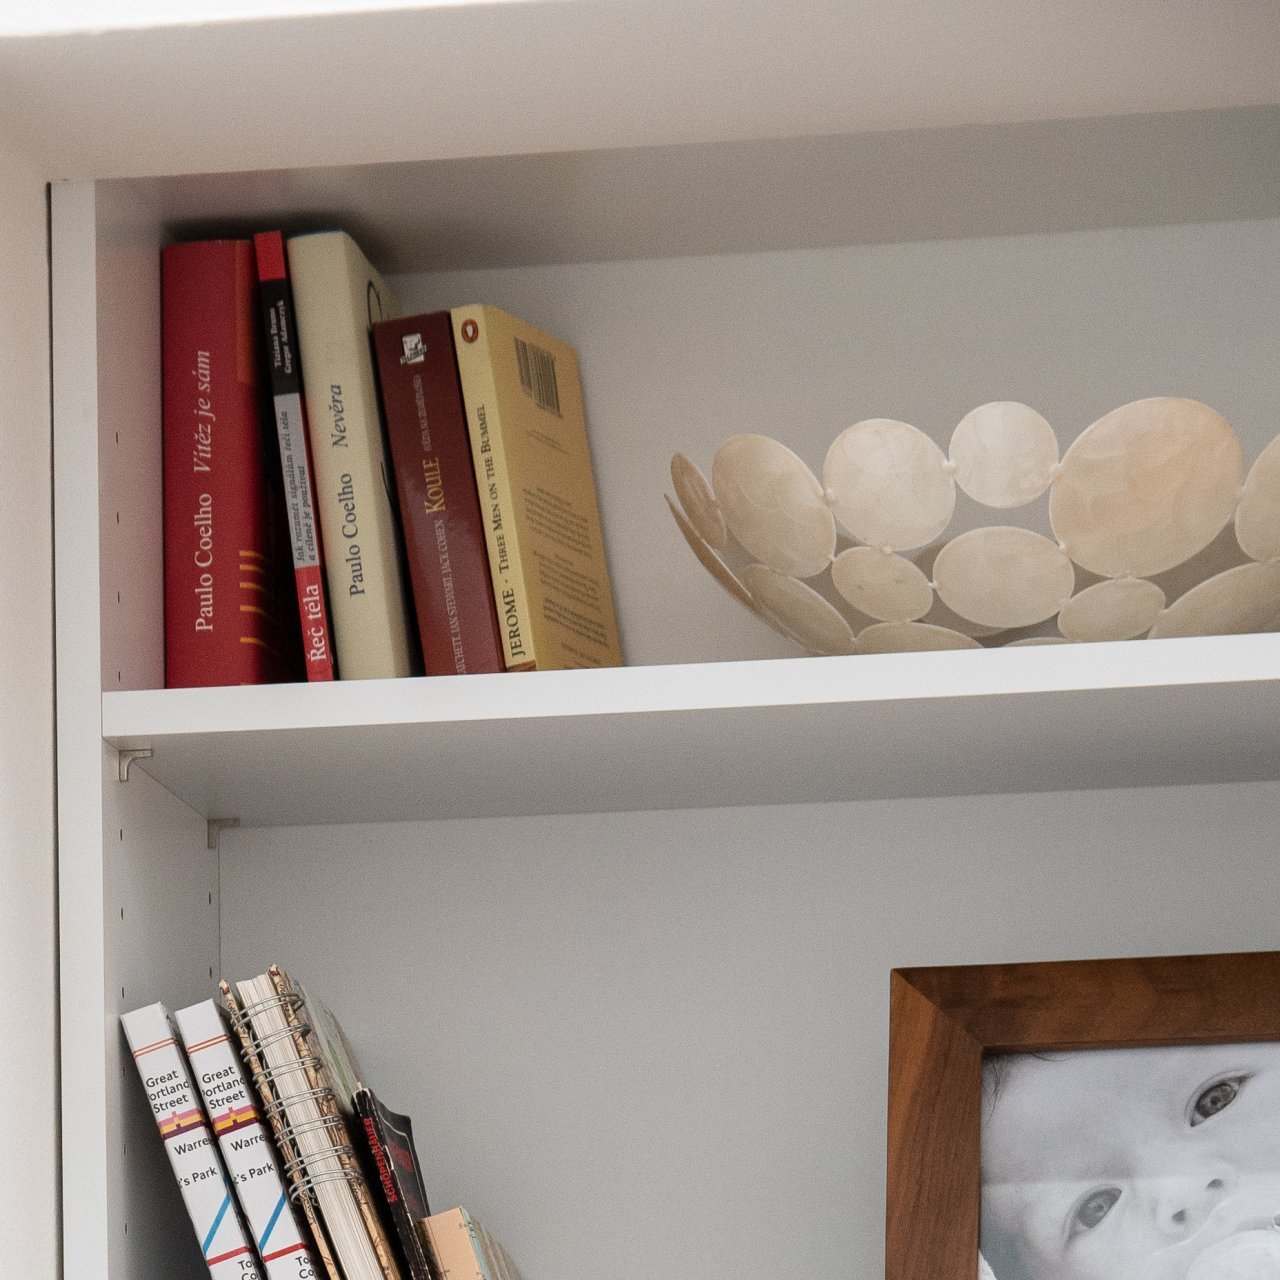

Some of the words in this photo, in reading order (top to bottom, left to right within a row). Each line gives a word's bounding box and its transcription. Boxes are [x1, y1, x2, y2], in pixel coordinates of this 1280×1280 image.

[191, 350, 210, 393] sám
[194, 397, 216, 422] je
[328, 383, 348, 447] Nevěra
[476, 404, 491, 454] BUMMEL
[192, 423, 211, 471] Vítěz
[337, 472, 358, 539] Coelho
[422, 458, 446, 515] KOULE
[193, 493, 213, 567] Coelho
[491, 502, 502, 531] MEN
[344, 544, 365, 596] Paulo
[495, 534, 509, 574] THREE
[194, 573, 213, 631] Paulo
[302, 584, 322, 620] těla
[501, 588, 525, 657] JEROME
[306, 626, 326, 661] Řeč
[202, 1065, 236, 1084] Great
[209, 1090, 246, 1110] Street
[248, 1163, 275, 1178] Park
